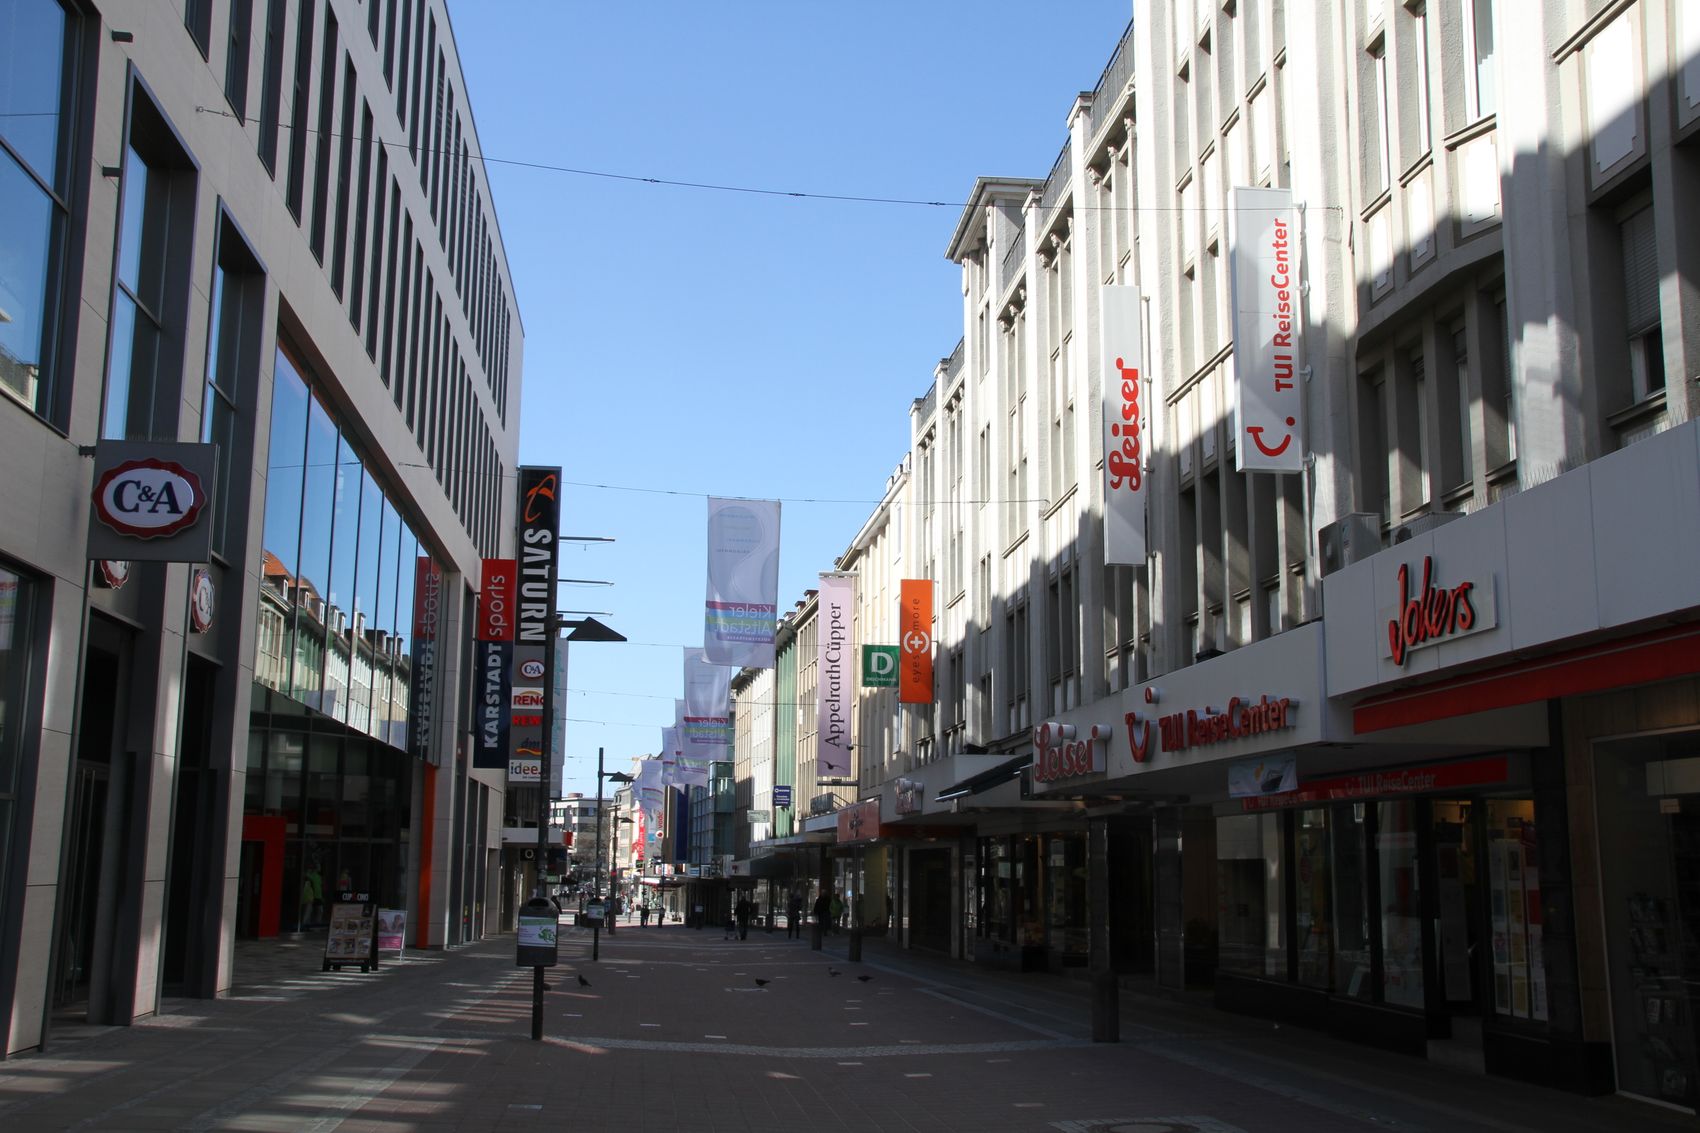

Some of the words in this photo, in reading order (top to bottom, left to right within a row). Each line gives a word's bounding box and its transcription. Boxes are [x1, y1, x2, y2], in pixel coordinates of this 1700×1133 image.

[1271, 217, 1292, 348] ReiseCenter
[1274, 354, 1294, 393] TUI
[1108, 357, 1142, 492] Leiser
[112, 479, 184, 515] C&A
[487, 575, 508, 636] sports
[519, 528, 553, 641] SATURN
[911, 597, 921, 632] more
[1388, 554, 1475, 667] Jokers
[484, 643, 502, 748] KARSTADT
[524, 664, 541, 675] C&A
[824, 602, 846, 748] AppelrathCüpper
[912, 654, 923, 684] eyes
[512, 715, 543, 727] REW
[1158, 712, 1184, 753] TUI
[1187, 694, 1290, 749] ReiseCenter
